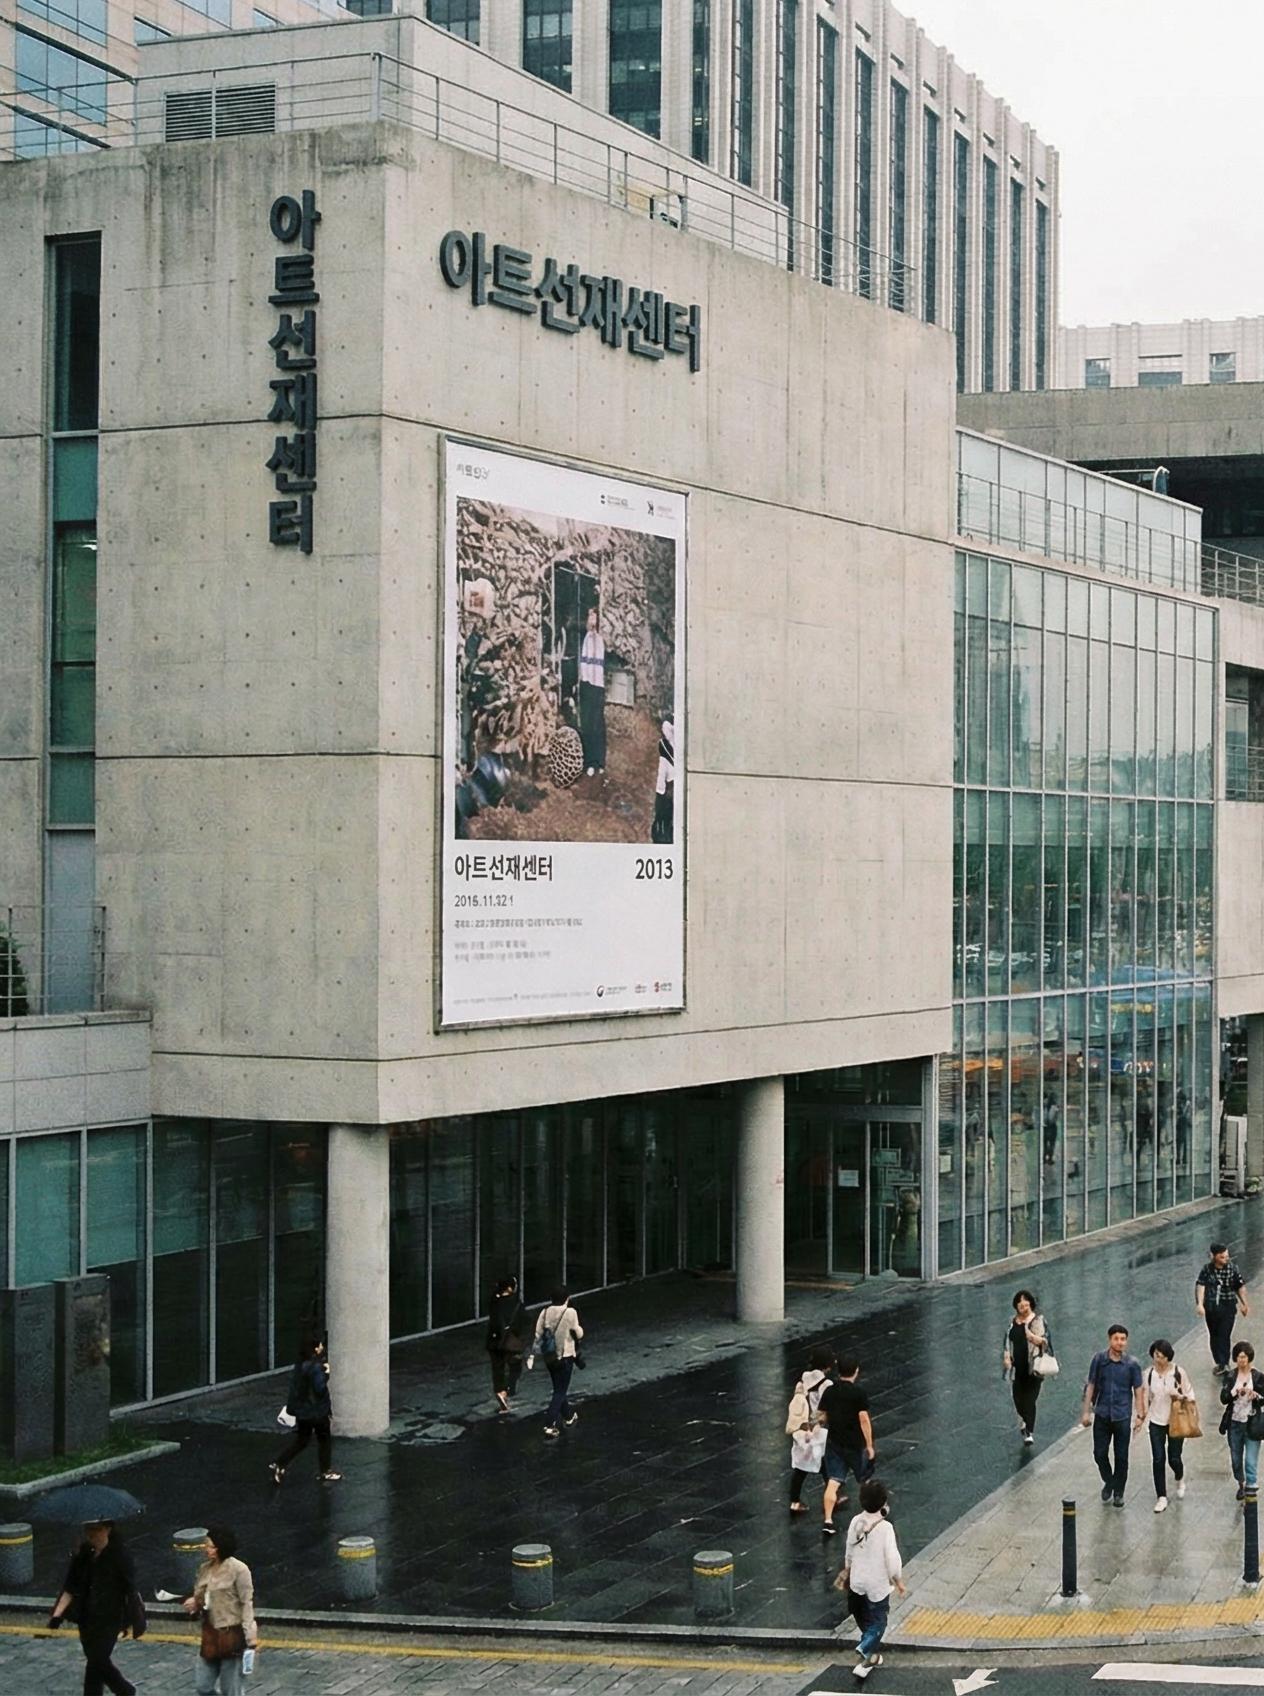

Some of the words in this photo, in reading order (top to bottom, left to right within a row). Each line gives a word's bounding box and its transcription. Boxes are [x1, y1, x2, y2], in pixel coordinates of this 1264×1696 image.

[439, 229, 701, 373] 아트선재센터
[268, 189, 321, 554] 아트선재센터
[454, 854, 553, 882] 아트선재센터
[635, 858, 674, 880] 2013
